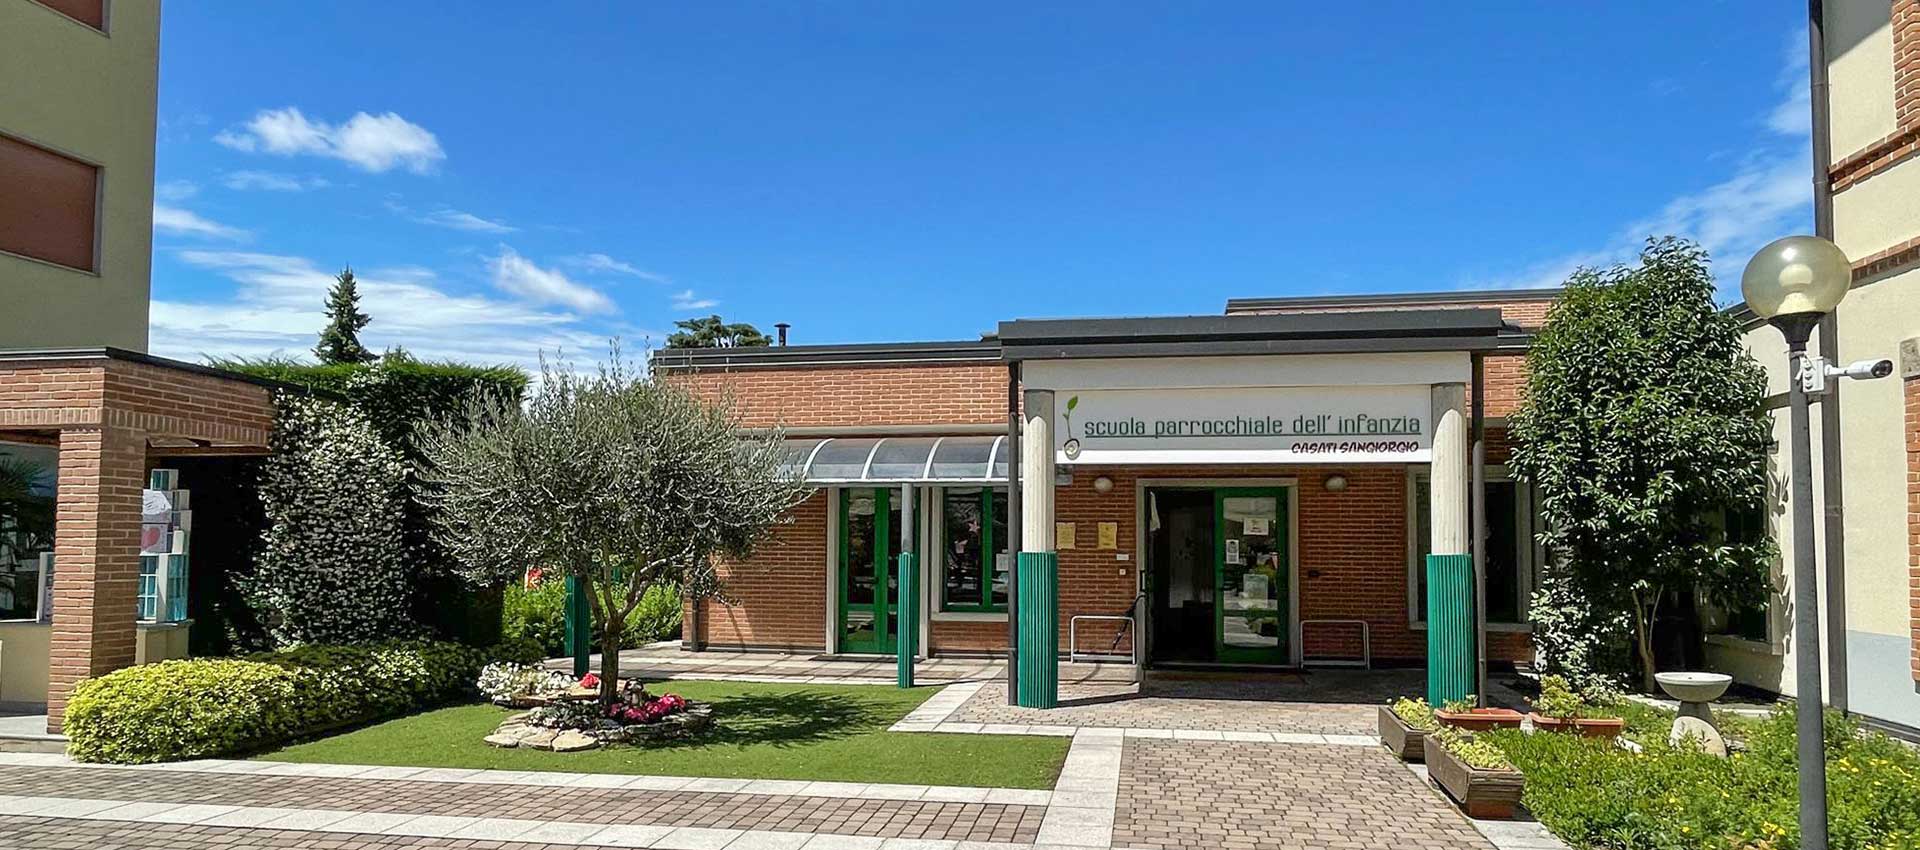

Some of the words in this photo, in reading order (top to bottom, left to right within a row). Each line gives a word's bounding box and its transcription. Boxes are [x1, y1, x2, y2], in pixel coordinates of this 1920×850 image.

[1084, 415, 1146, 436] scuola
[1154, 415, 1283, 438] parrocchiale
[1292, 414, 1331, 434] dell'
[1338, 413, 1421, 434] infanzia
[1291, 441, 1337, 454] CASATI
[1338, 440, 1419, 453] SANGIORGIO
